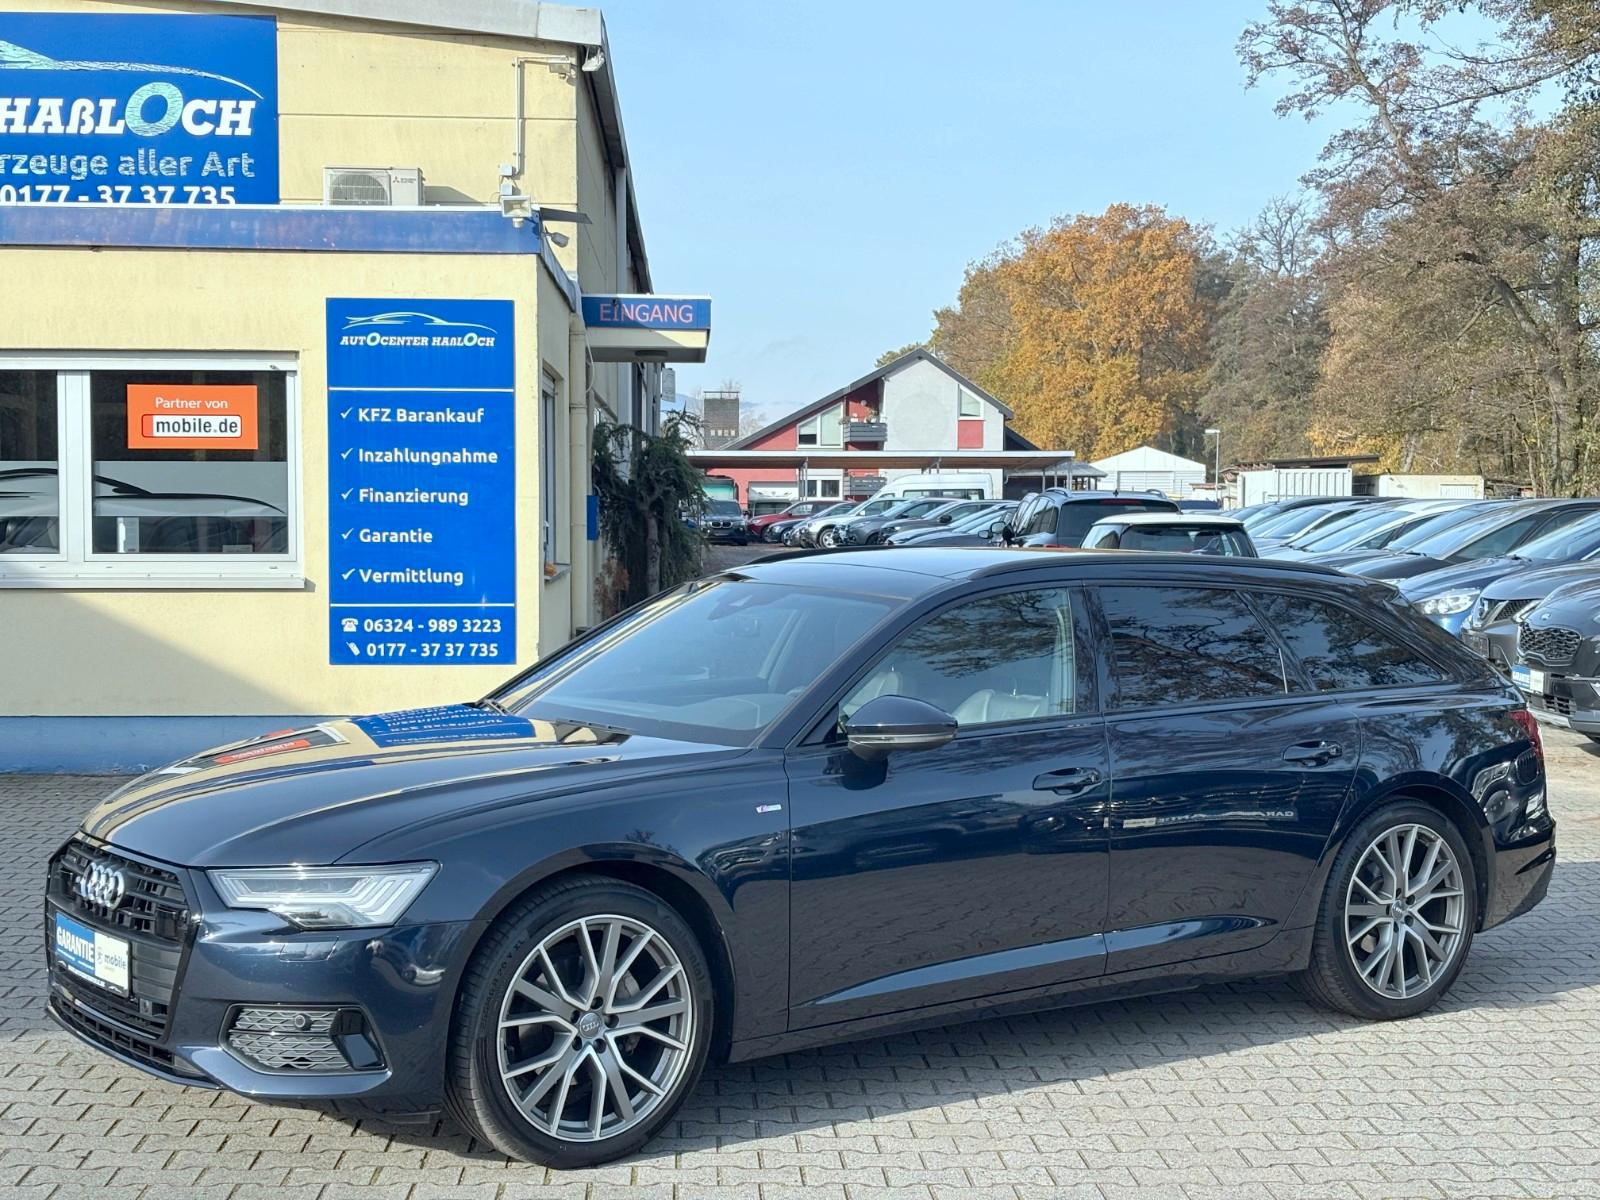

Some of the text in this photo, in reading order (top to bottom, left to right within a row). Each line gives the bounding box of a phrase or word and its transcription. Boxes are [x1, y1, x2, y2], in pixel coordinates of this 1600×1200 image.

[118, 148, 192, 176] aller
[201, 151, 255, 178] Art
[0, 185, 71, 203] 0177
[97, 185, 132, 203] 37
[140, 185, 176, 203] 37
[183, 185, 236, 203] 735
[600, 303, 693, 323] EINGANG
[340, 332, 429, 347] AUTOCENTER
[155, 397, 228, 410] Partner von
[358, 408, 485, 422] KFZ Barankauf
[155, 418, 238, 434] mobile.de
[358, 447, 498, 466] Inzahlungnahme
[359, 488, 469, 507] Finanzierung
[359, 528, 433, 543] Garantie
[359, 568, 464, 586] Vermittlung
[363, 619, 413, 633] 06324
[428, 619, 457, 633] 989
[462, 619, 502, 633] 3223
[366, 643, 407, 657] 0177
[421, 643, 440, 657] 37
[445, 643, 465, 657] 37
[469, 643, 498, 657] 735
[56, 926, 95, 963] GARANTIE
